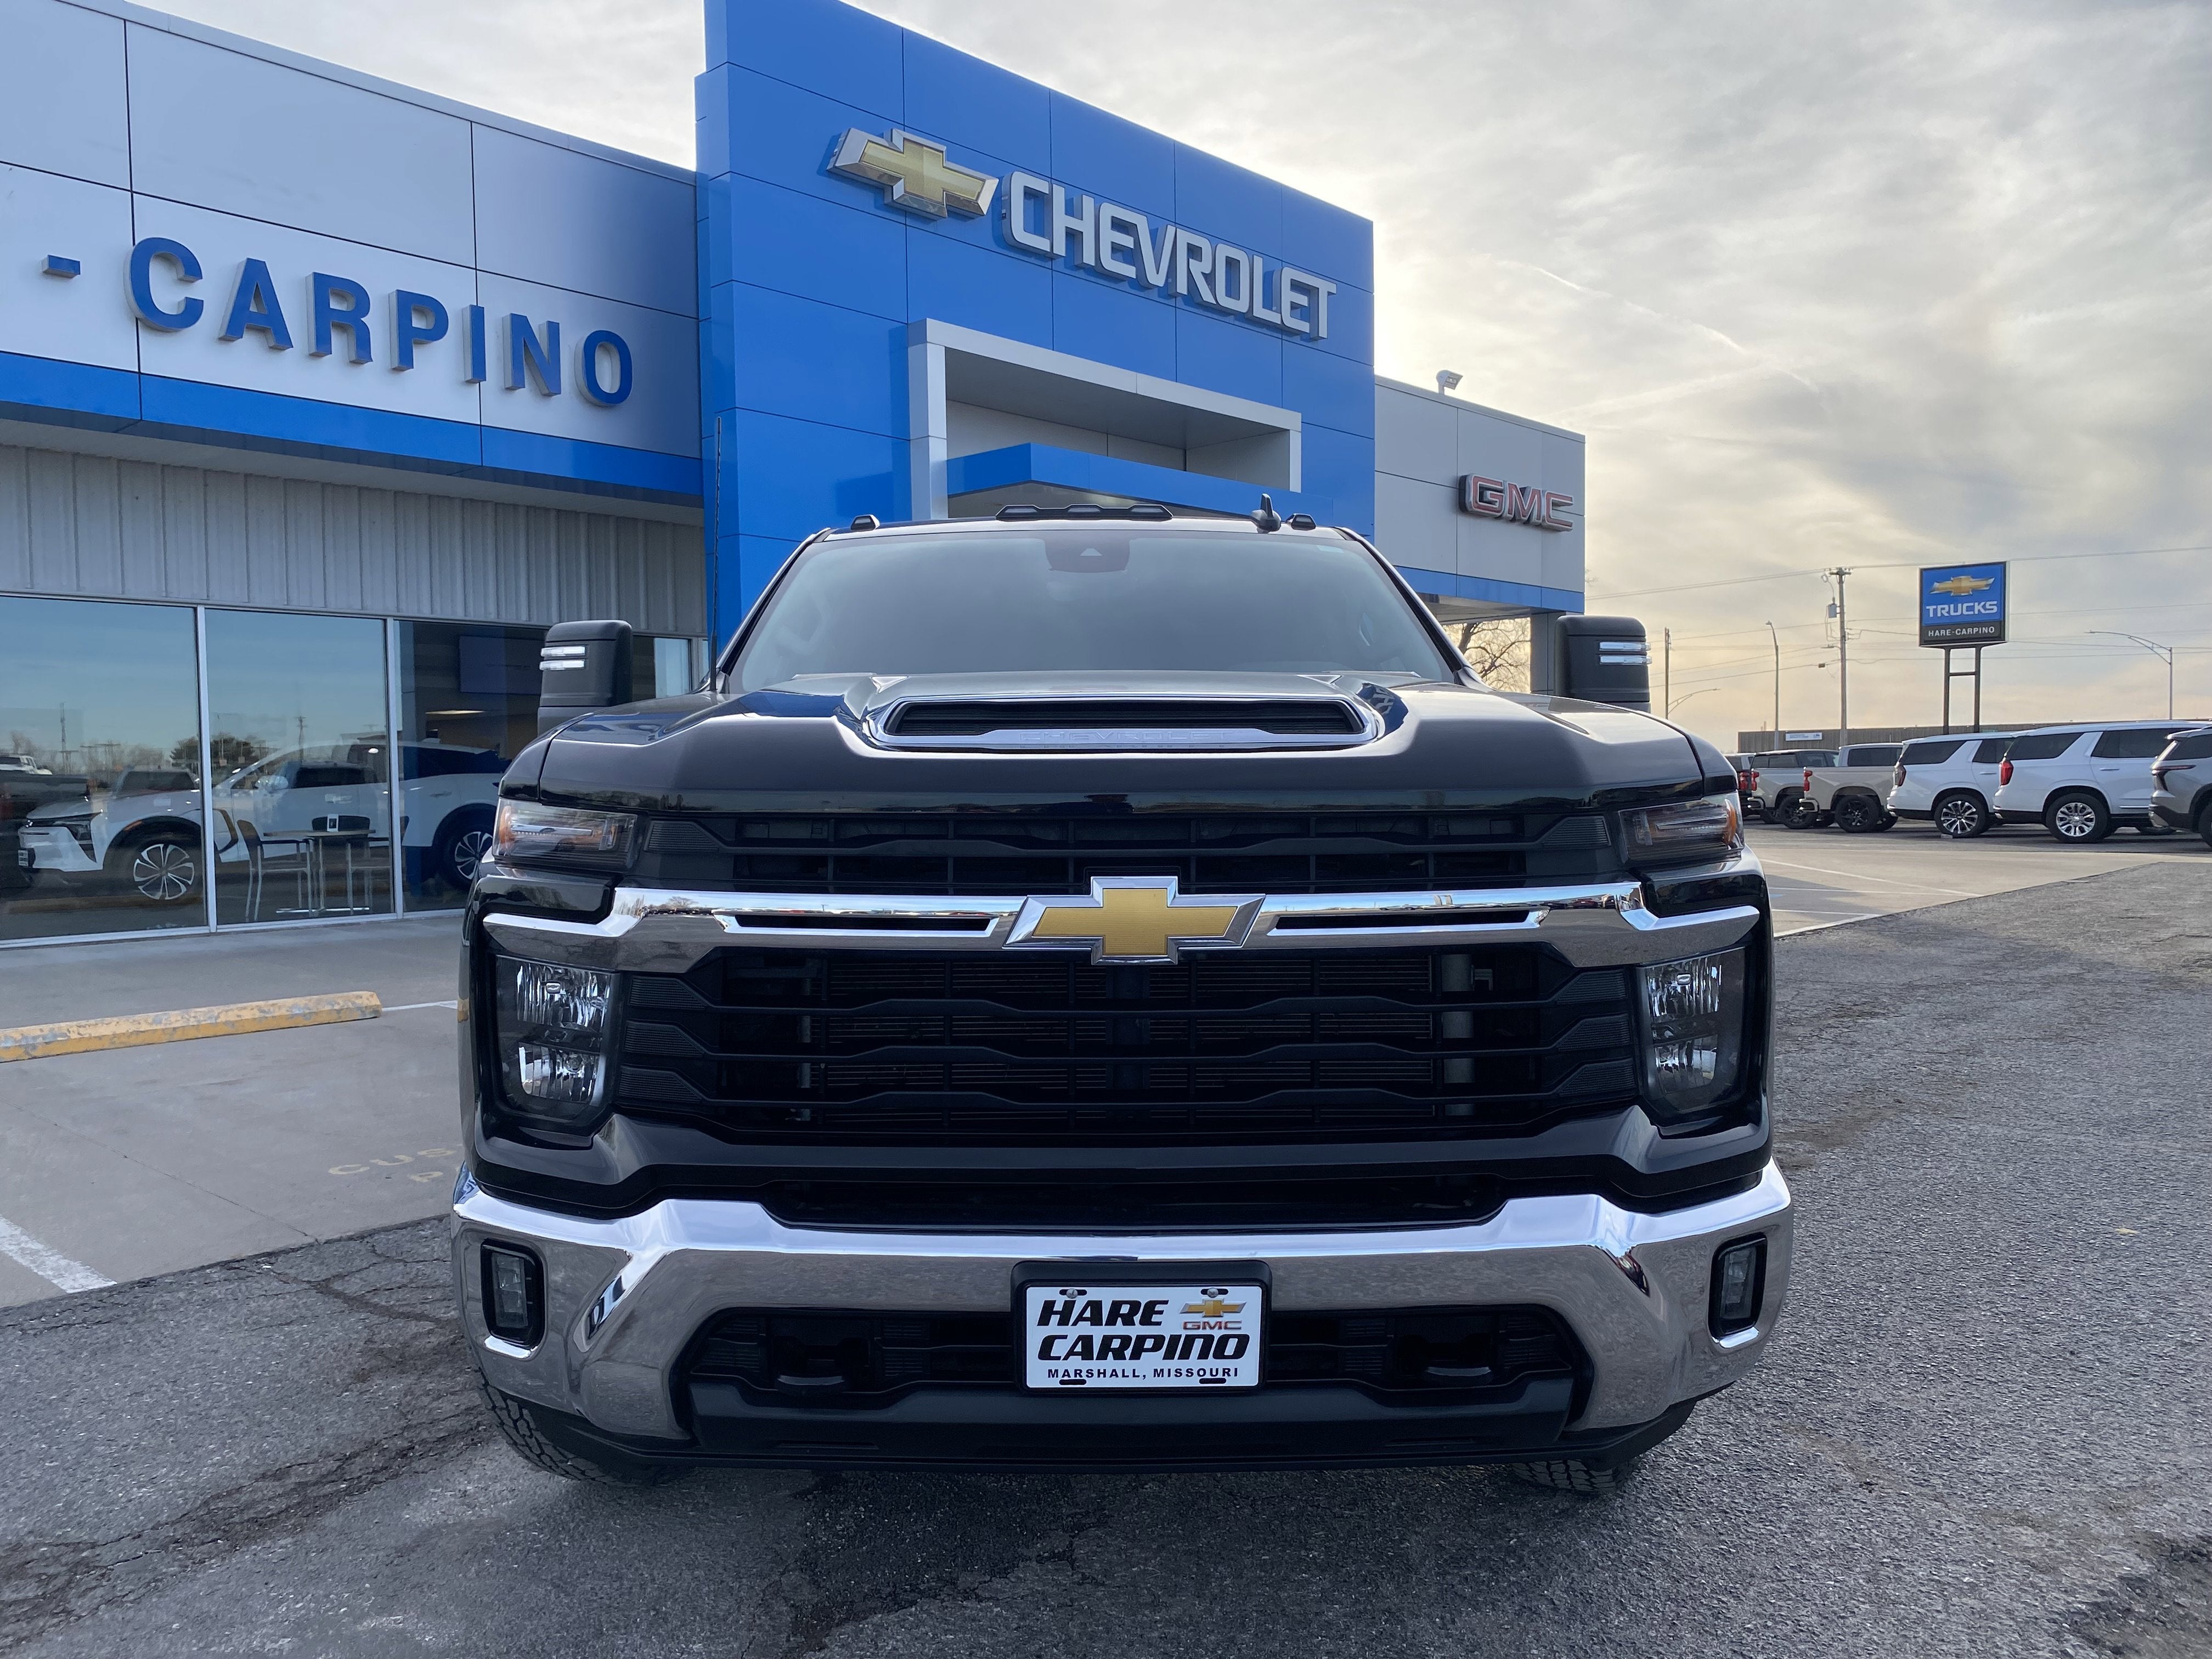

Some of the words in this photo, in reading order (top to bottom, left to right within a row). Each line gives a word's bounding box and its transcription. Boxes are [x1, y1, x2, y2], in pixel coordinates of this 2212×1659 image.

[1002, 171, 1337, 341] CHEVROLET
[125, 238, 634, 407] CARPINO
[1459, 473, 1574, 531] GMC
[1926, 601, 1997, 617] TRUCKS
[1928, 627, 1995, 637] HARE-CARPINO
[1019, 731, 1233, 741] CHEVROLET
[1037, 1300, 1170, 1327] HARE
[1182, 1321, 1242, 1330] GMC
[1037, 1334, 1250, 1361] CARPINO
[1047, 1368, 1147, 1380] MARSHALL,
[1153, 1367, 1238, 1378] MISSOURI
